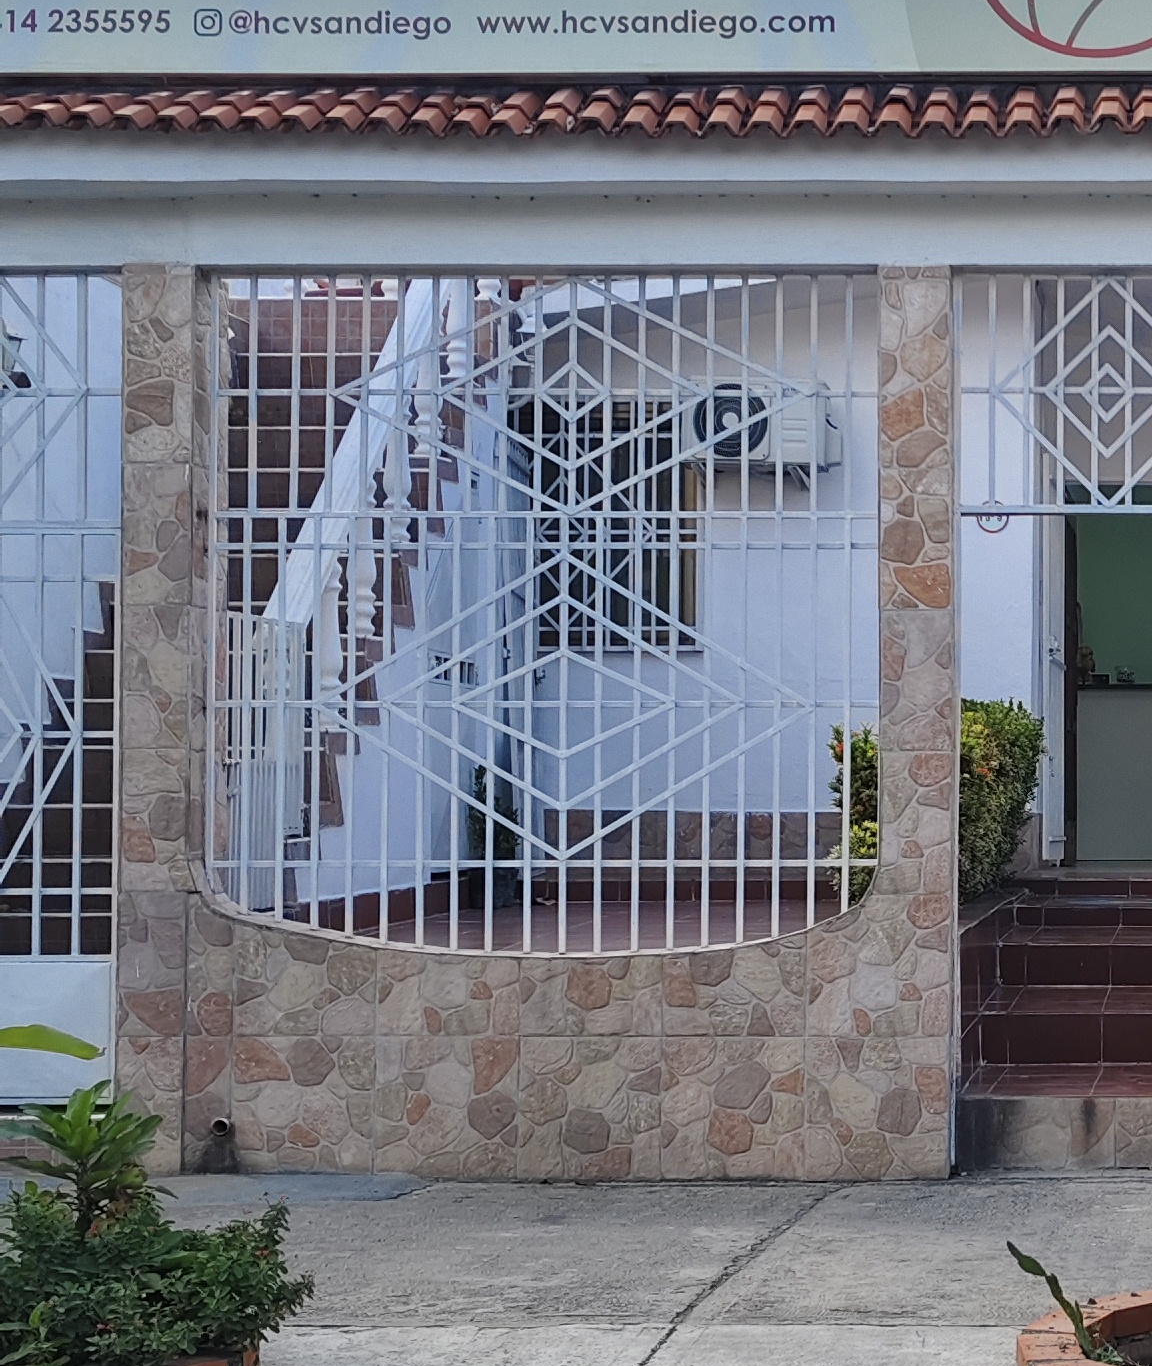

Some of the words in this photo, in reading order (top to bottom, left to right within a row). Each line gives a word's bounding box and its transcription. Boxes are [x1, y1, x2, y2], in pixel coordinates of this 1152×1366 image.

[0, 8, 38, 33] 14
[47, 8, 171, 34] 2355595
[228, 9, 452, 40] @hcvsandiego
[476, 9, 836, 40] www.hcvsandiego.com
